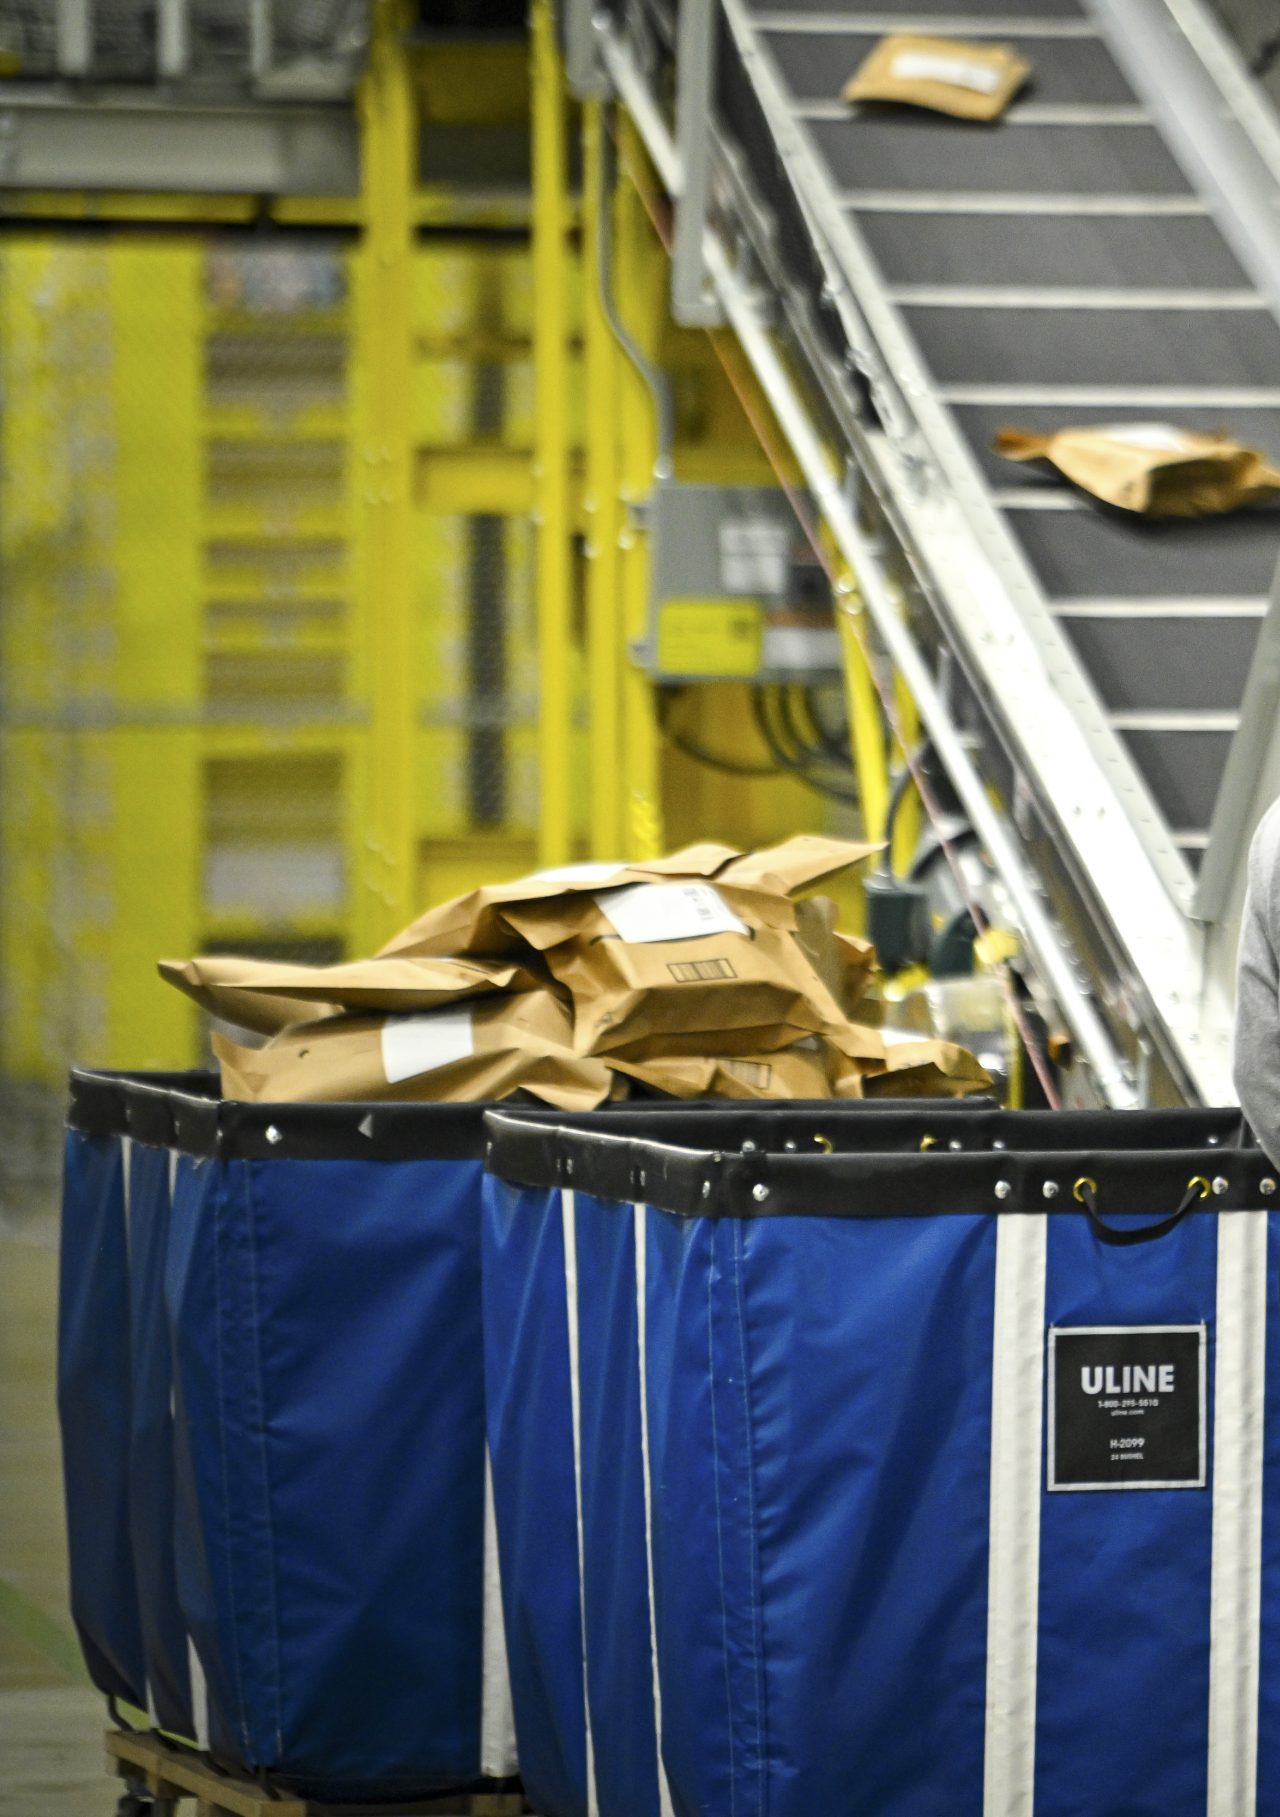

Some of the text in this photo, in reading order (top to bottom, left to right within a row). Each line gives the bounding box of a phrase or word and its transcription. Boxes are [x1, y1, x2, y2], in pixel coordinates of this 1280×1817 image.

[1081, 1365, 1174, 1394] ULINE
[1098, 1399, 1159, 1408] 1-800-295-5510
[1110, 1438, 1145, 1449] H-2099
